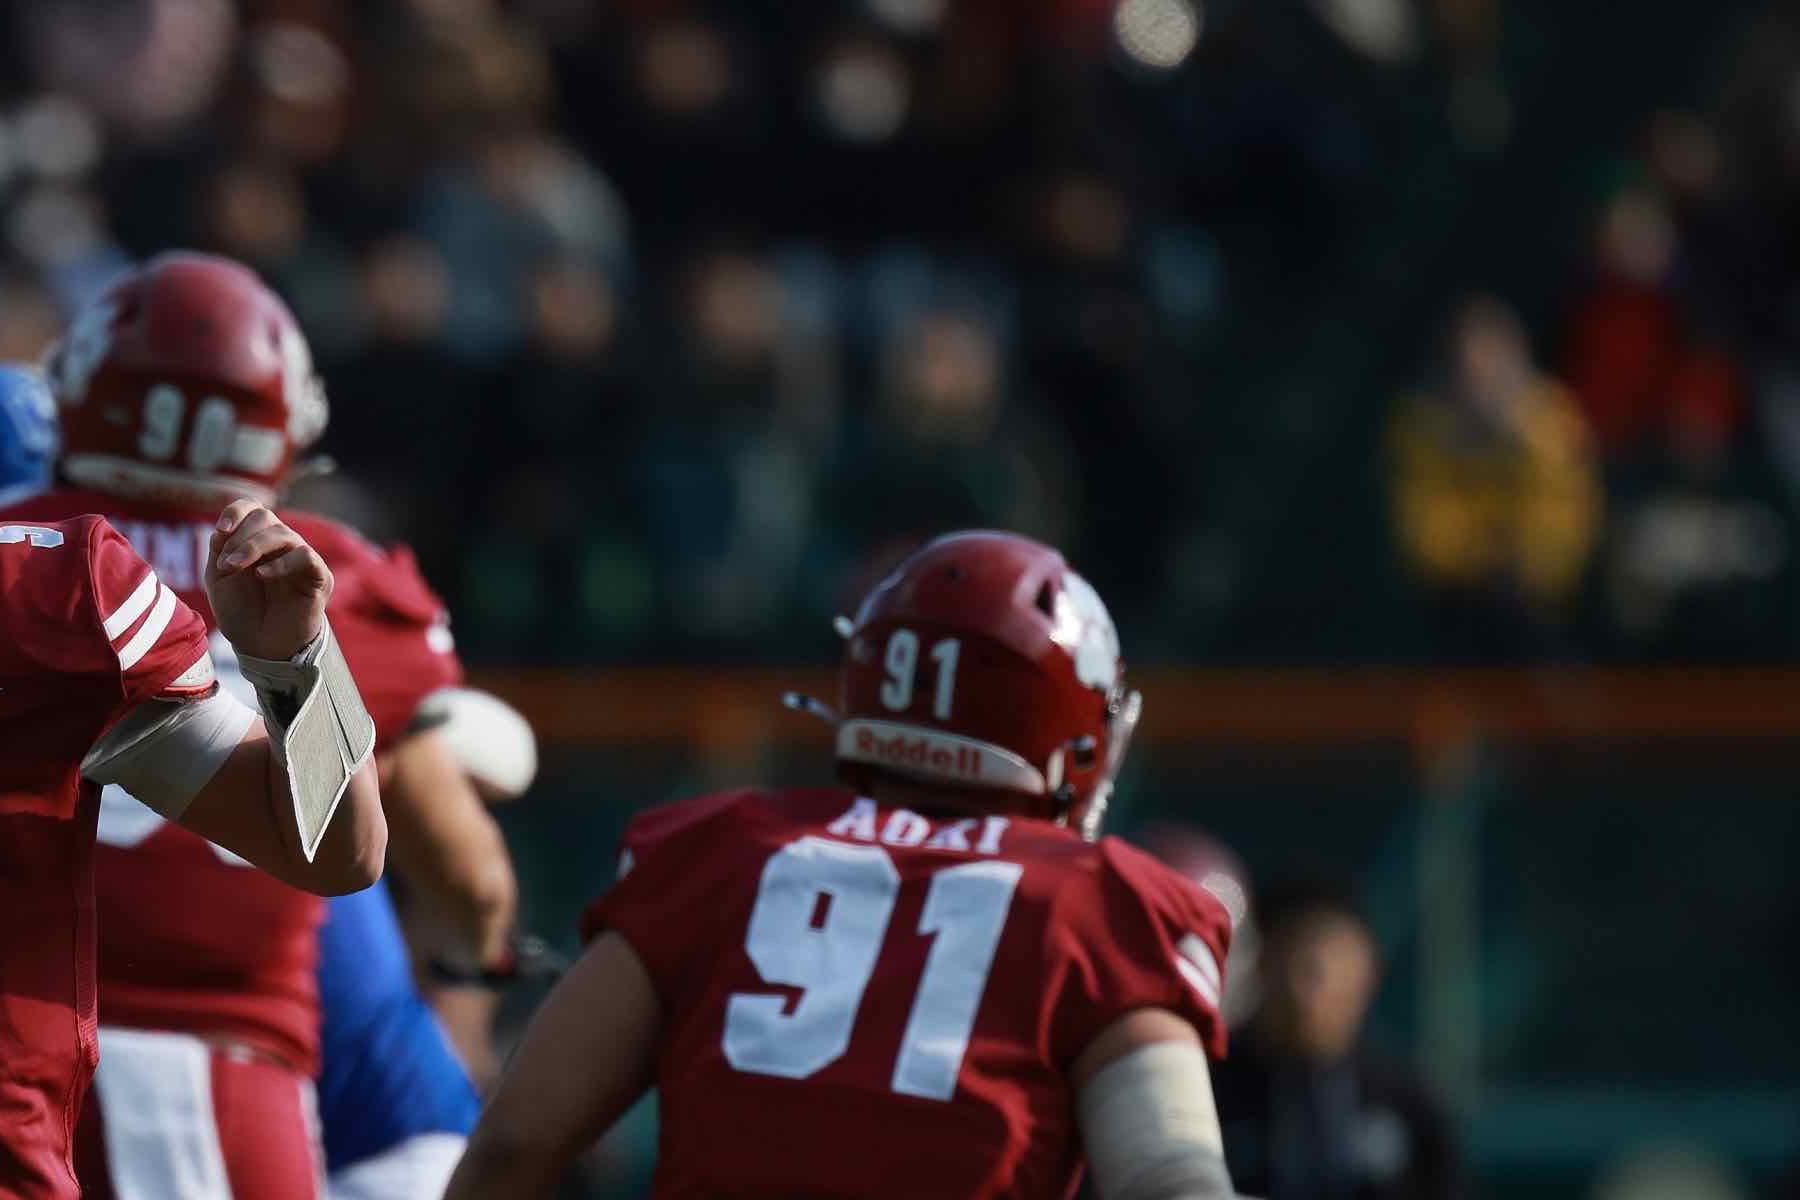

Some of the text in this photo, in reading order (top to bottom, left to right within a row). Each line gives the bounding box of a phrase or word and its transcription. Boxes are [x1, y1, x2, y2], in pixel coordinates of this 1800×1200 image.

[879, 627, 962, 722] 91
[855, 725, 985, 779] Riddell
[721, 835, 1023, 1101] 91
